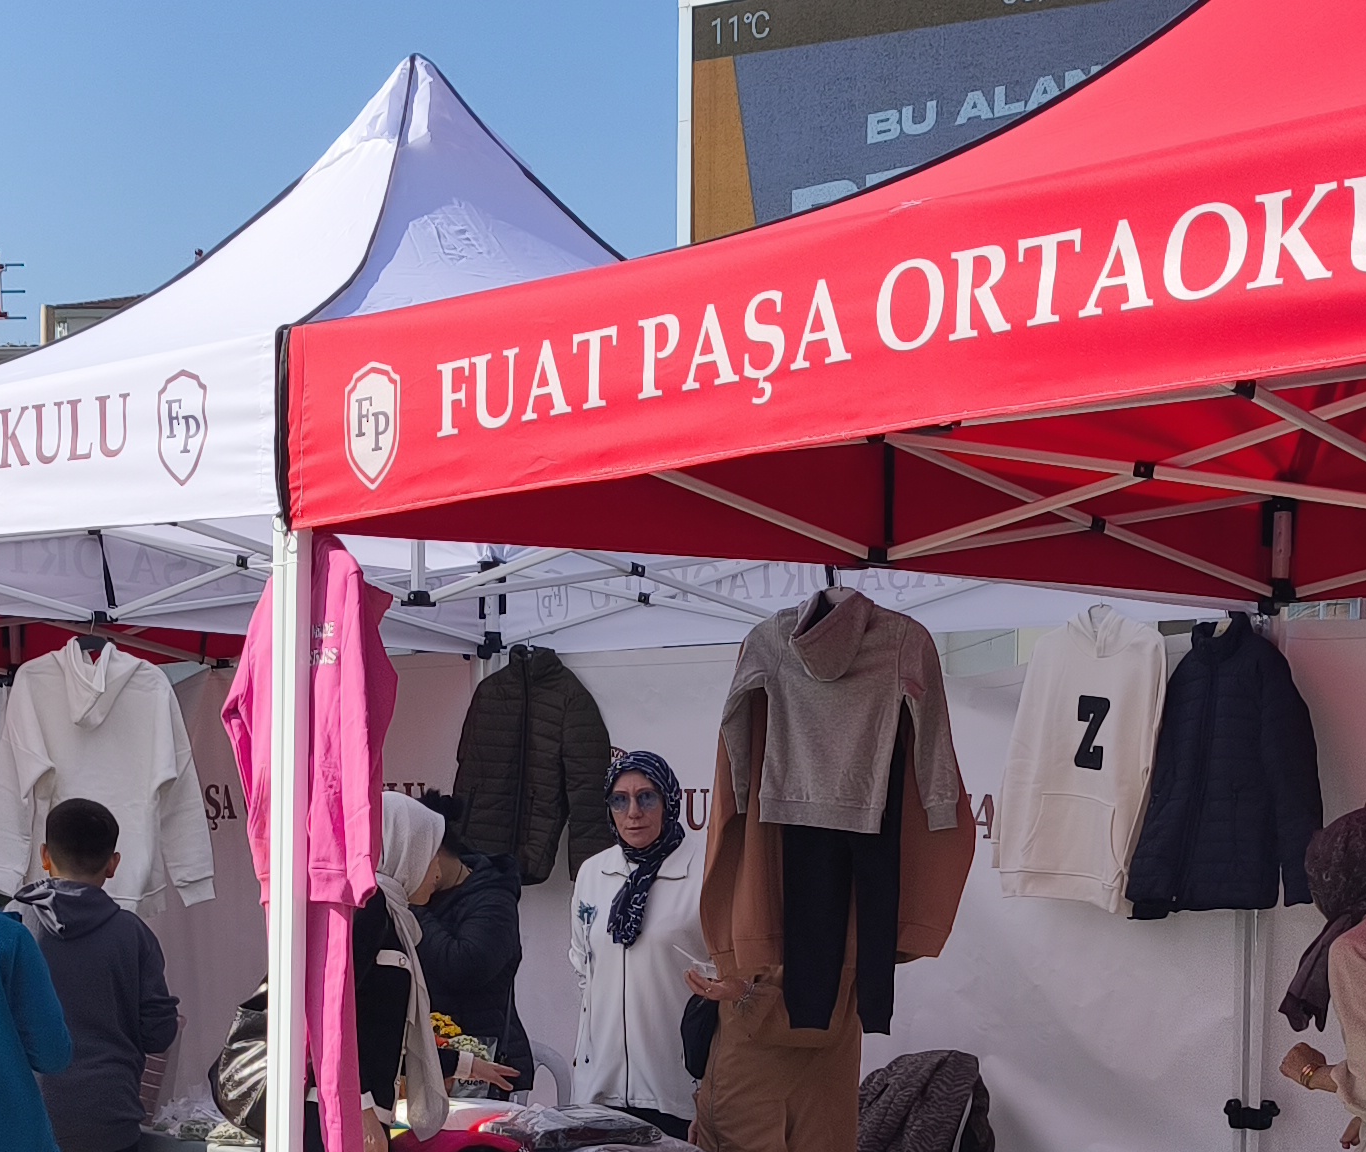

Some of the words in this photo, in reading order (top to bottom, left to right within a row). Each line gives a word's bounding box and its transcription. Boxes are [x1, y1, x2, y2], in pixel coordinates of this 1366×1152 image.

[866, 100, 937, 145] BU
[435, 323, 619, 439] FUAT
[635, 276, 853, 406] PAŞA
[165, 397, 201, 455] FP
[354, 395, 391, 453] FP
[1074, 695, 1110, 770] Z
